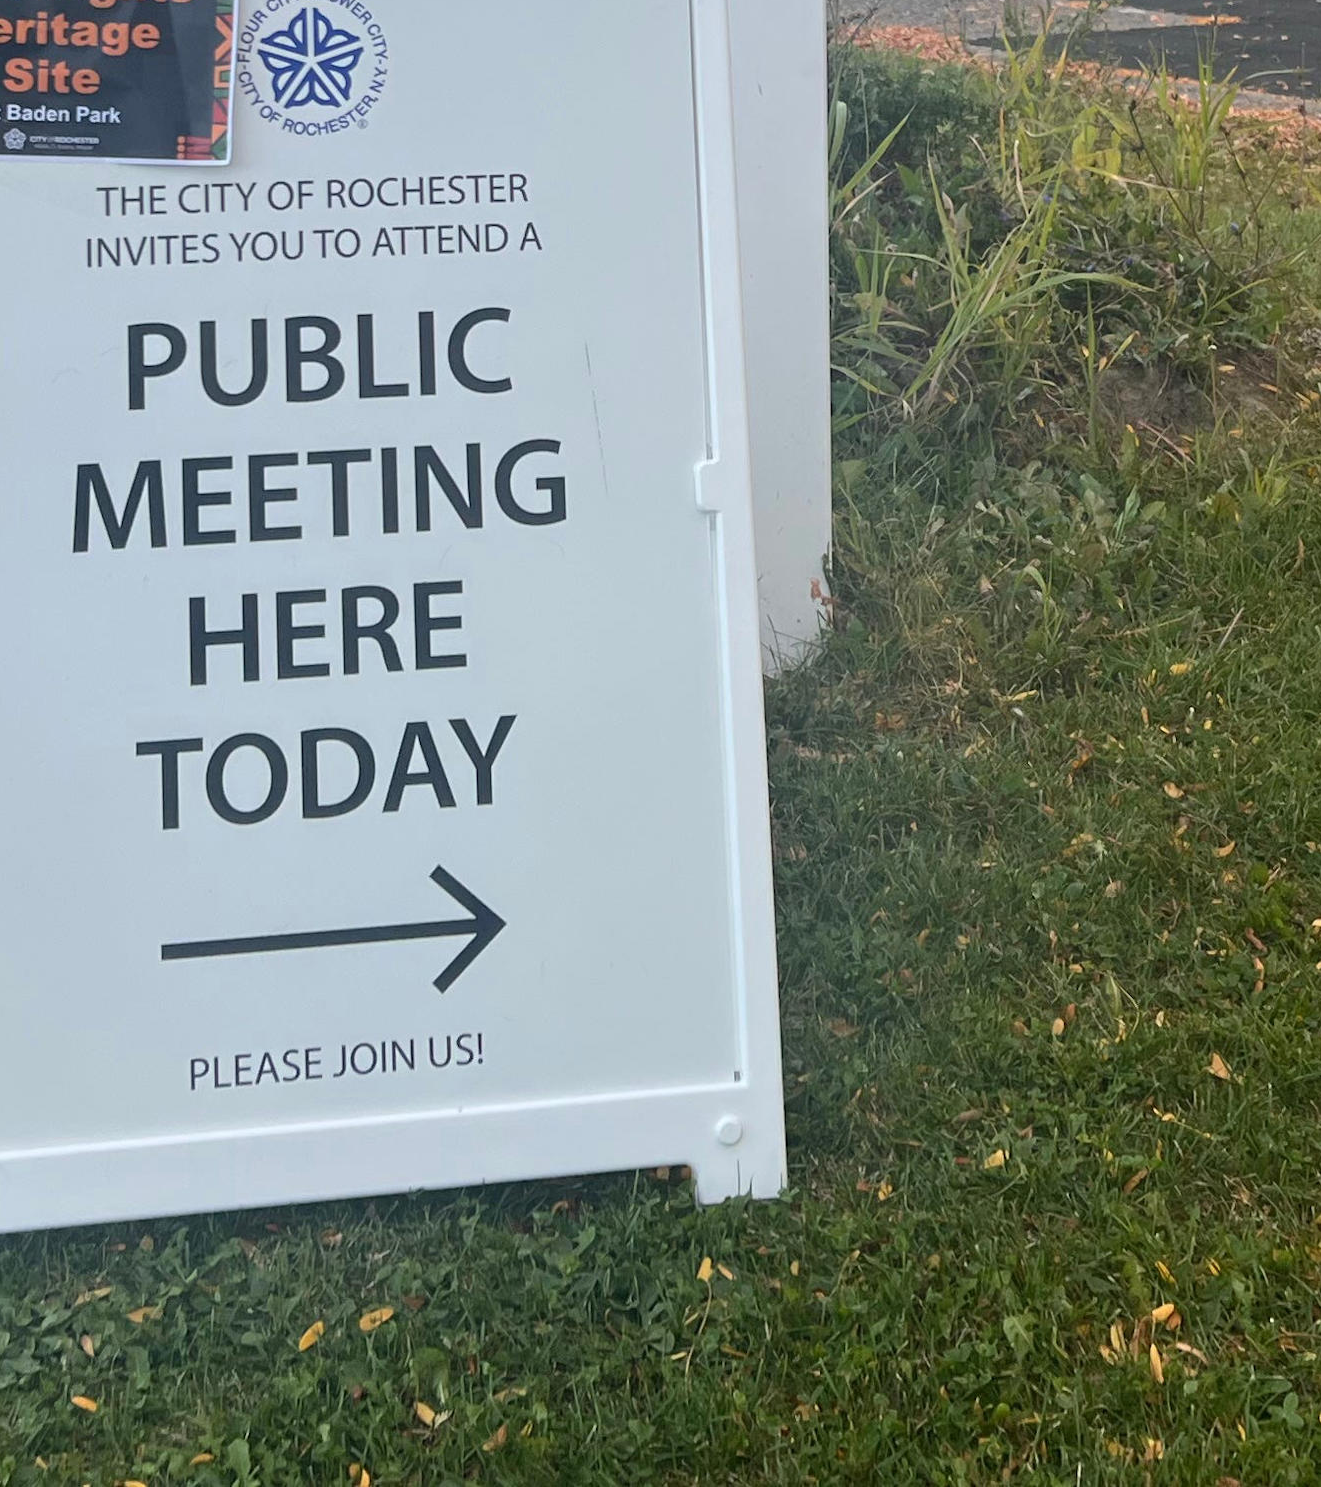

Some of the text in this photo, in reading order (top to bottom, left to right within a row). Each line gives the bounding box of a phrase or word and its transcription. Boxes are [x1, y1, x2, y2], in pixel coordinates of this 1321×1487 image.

[2, 58, 101, 94] Site
[7, 104, 70, 123] Baden
[76, 106, 121, 124] Park
[260, 105, 281, 123] OF
[97, 173, 528, 217] THE CITY OF ROCHESTER
[86, 222, 542, 268] INVITES YOU TO ATTEND A
[126, 306, 513, 411] PUBLIC
[72, 438, 567, 554] MEETING
[188, 580, 468, 686] HERE
[135, 715, 517, 831] TODAY
[189, 1033, 484, 1091] PLEASE JOIN US!
